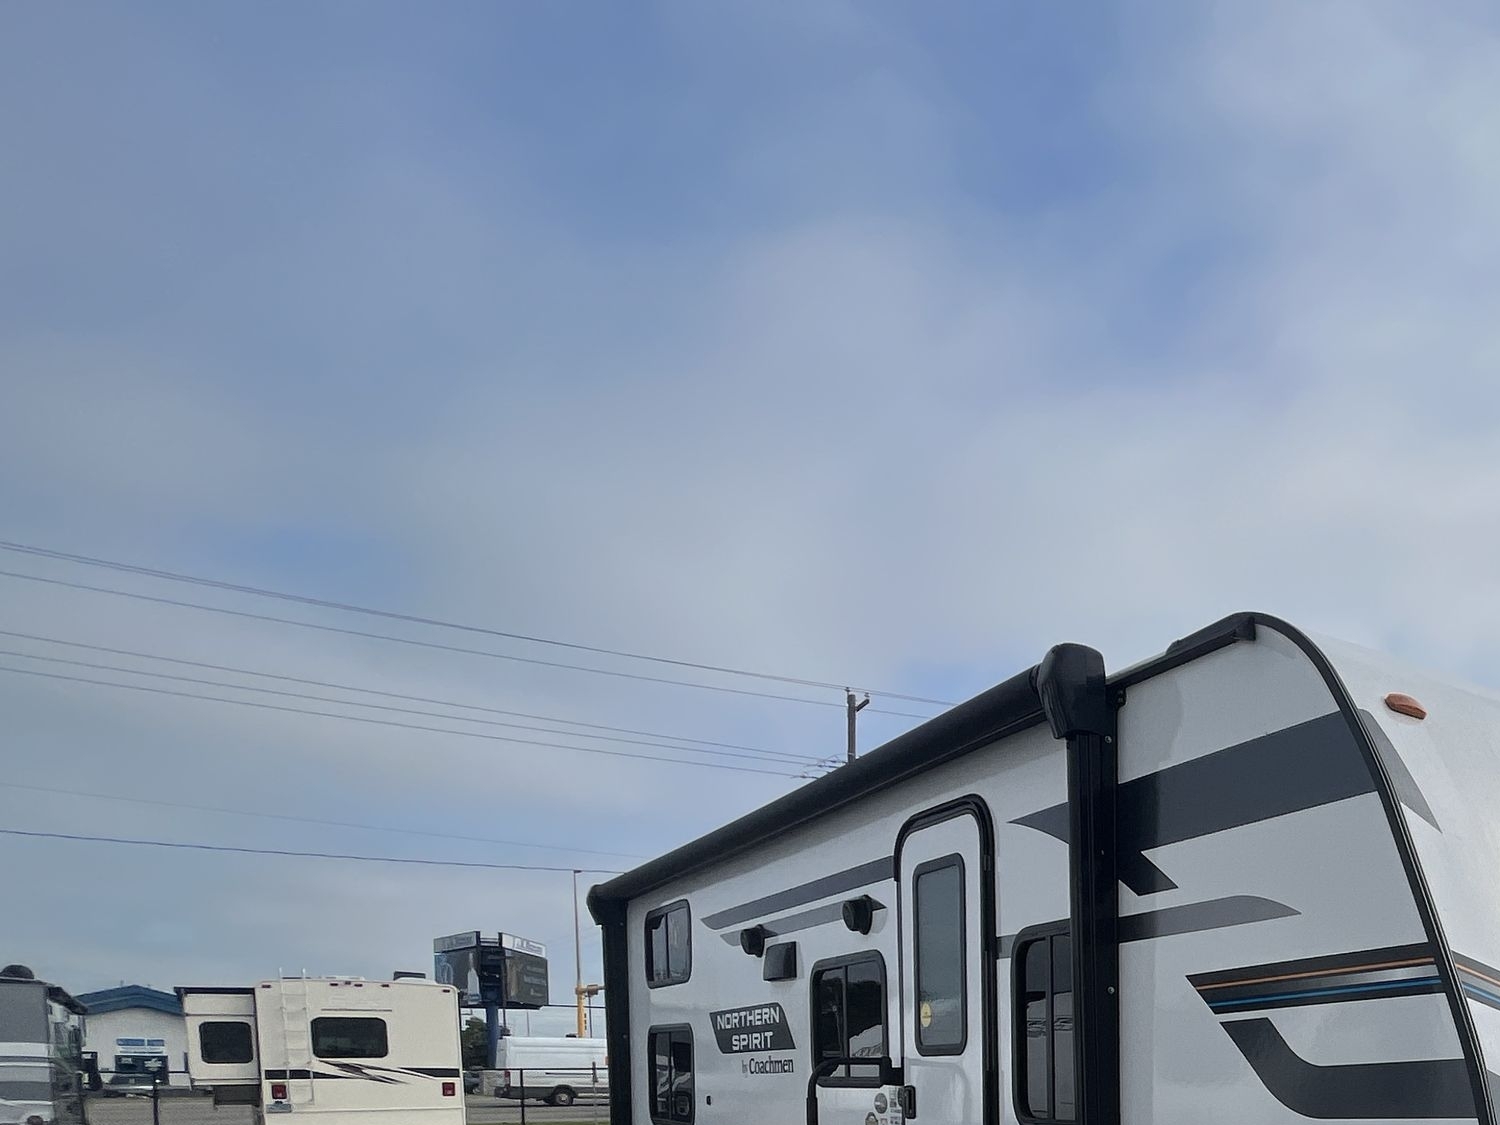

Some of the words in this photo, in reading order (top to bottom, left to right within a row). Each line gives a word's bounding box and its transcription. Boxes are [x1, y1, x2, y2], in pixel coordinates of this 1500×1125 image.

[716, 1006, 780, 1031] NORTHERN
[731, 1031, 774, 1051] SPIRIT
[749, 1055, 794, 1074] Coachmen
